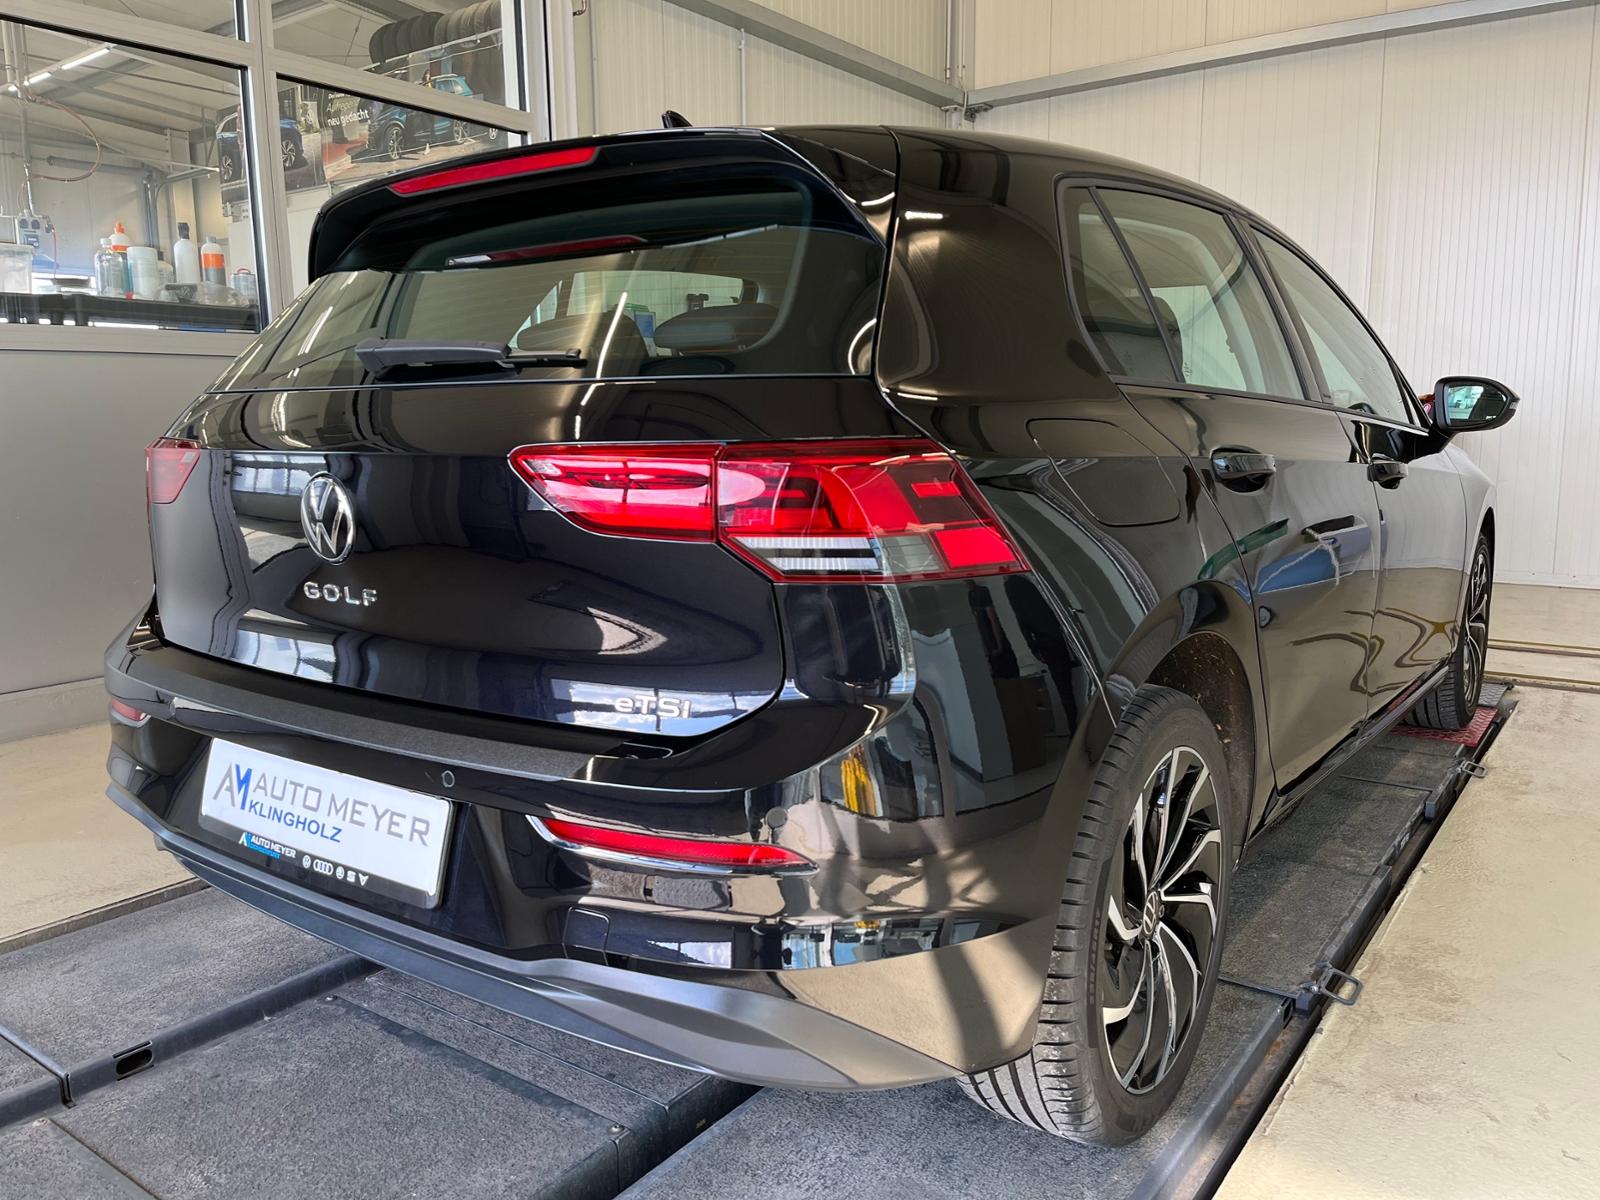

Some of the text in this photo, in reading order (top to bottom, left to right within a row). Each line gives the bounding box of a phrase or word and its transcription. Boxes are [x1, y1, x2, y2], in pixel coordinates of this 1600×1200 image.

[327, 109, 370, 127] neu gedacht
[303, 581, 378, 607] GOLF
[248, 799, 343, 844] KLINGHOLZ
[252, 772, 431, 848] AUTO MEYER
[250, 834, 271, 850] AUTO
[270, 841, 297, 859] MEYER
